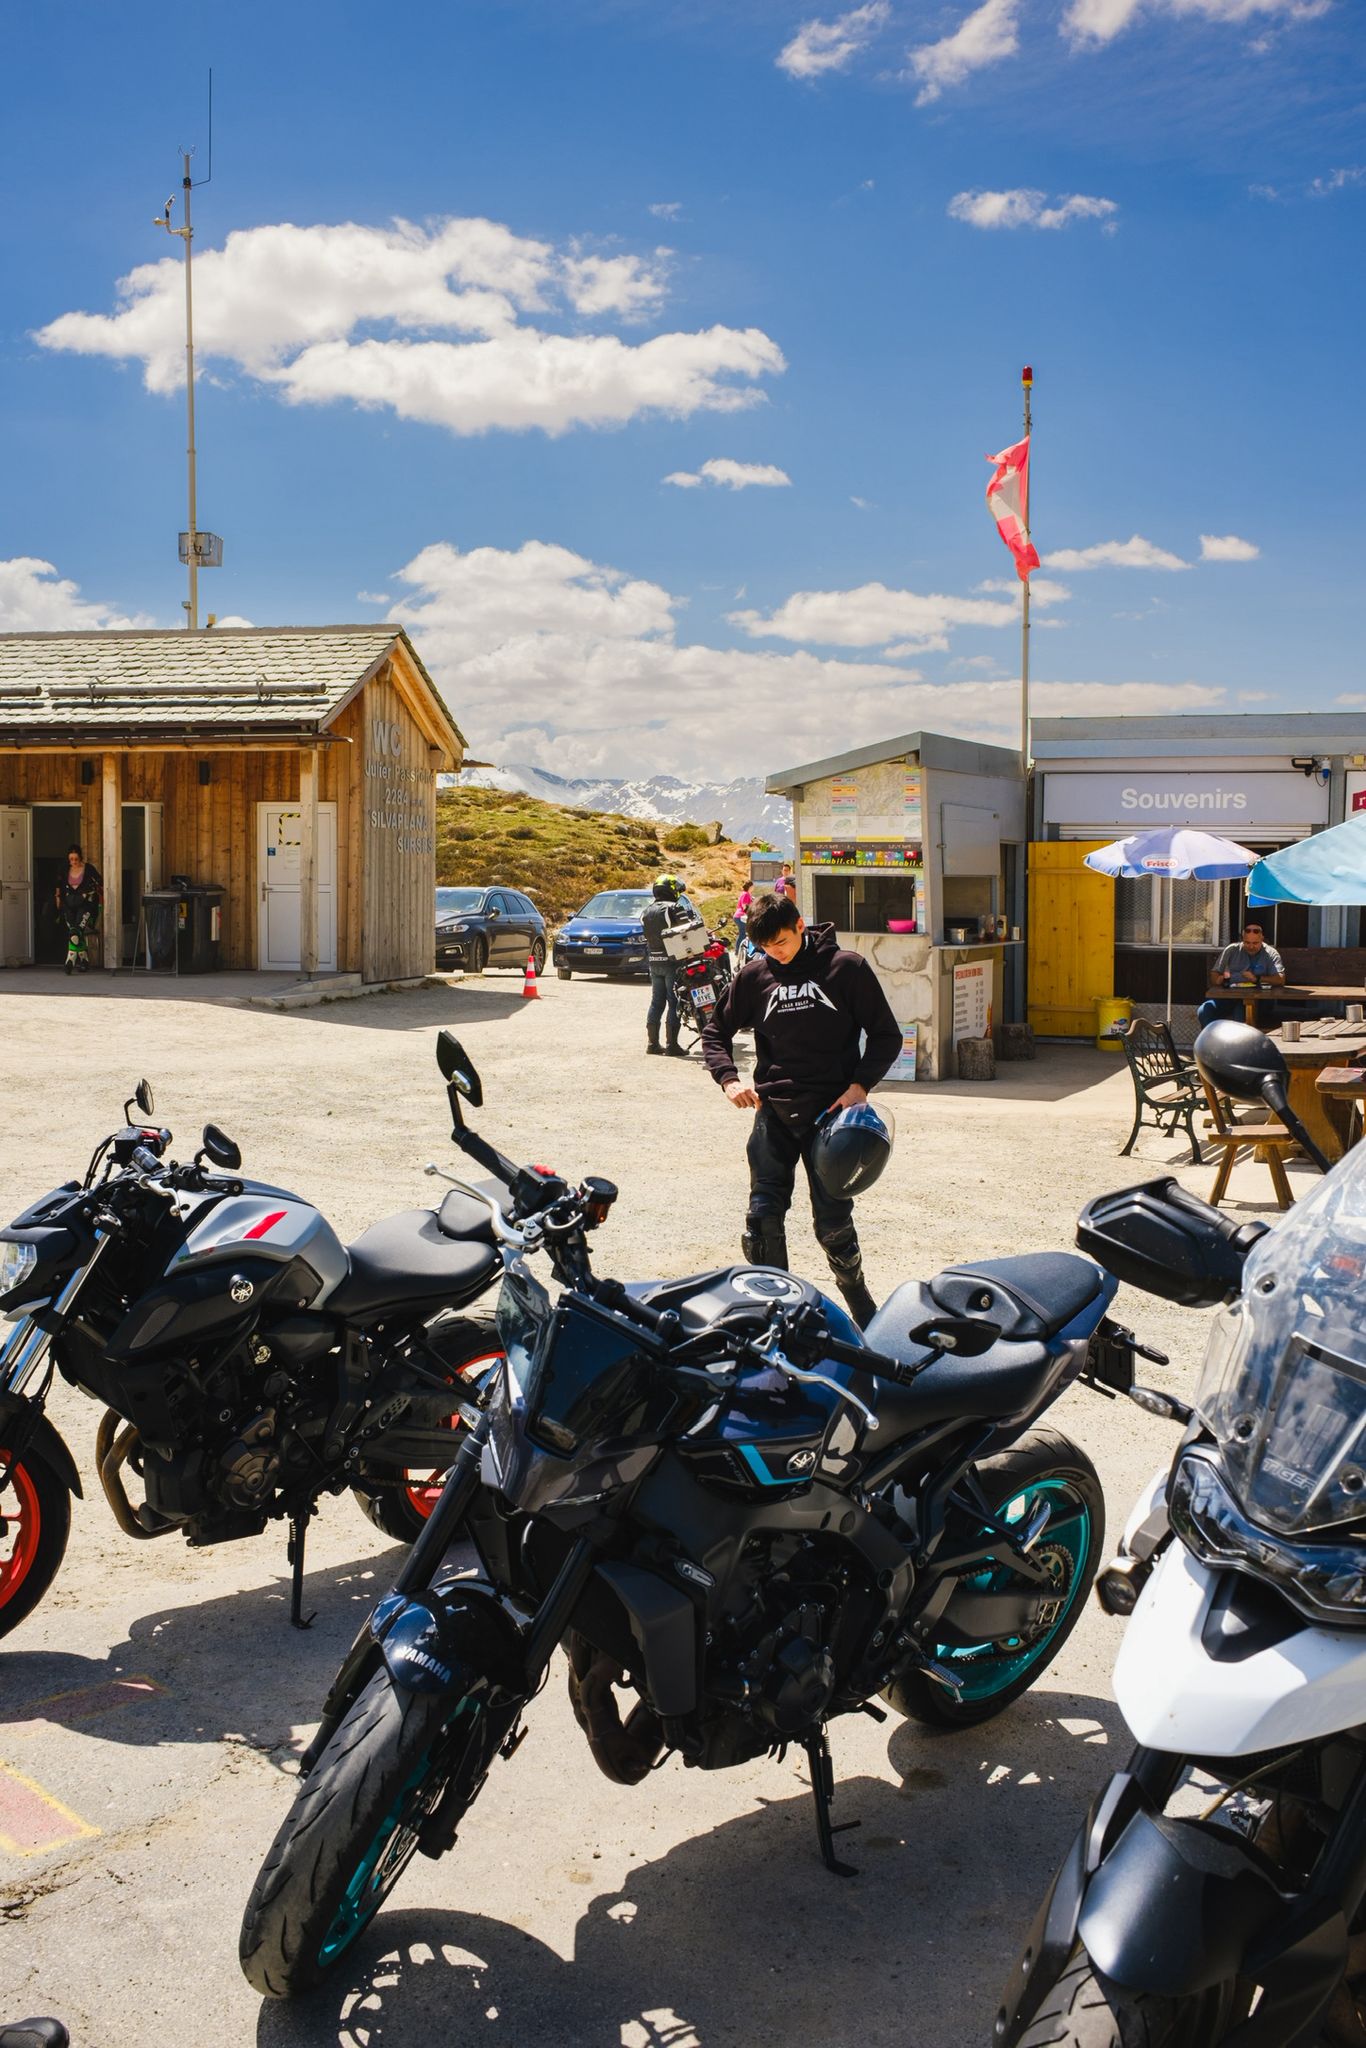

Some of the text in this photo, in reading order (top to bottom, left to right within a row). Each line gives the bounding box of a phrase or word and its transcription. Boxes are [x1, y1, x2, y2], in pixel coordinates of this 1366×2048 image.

[372, 720, 401, 757] WC
[365, 760, 391, 780] Julier
[385, 788, 408, 806] 2284
[1121, 788, 1247, 809] Souvenirs
[1146, 860, 1176, 868] Frisco
[1263, 1457, 1317, 1494] TIGER
[402, 1646, 452, 1684] YAMAHA
